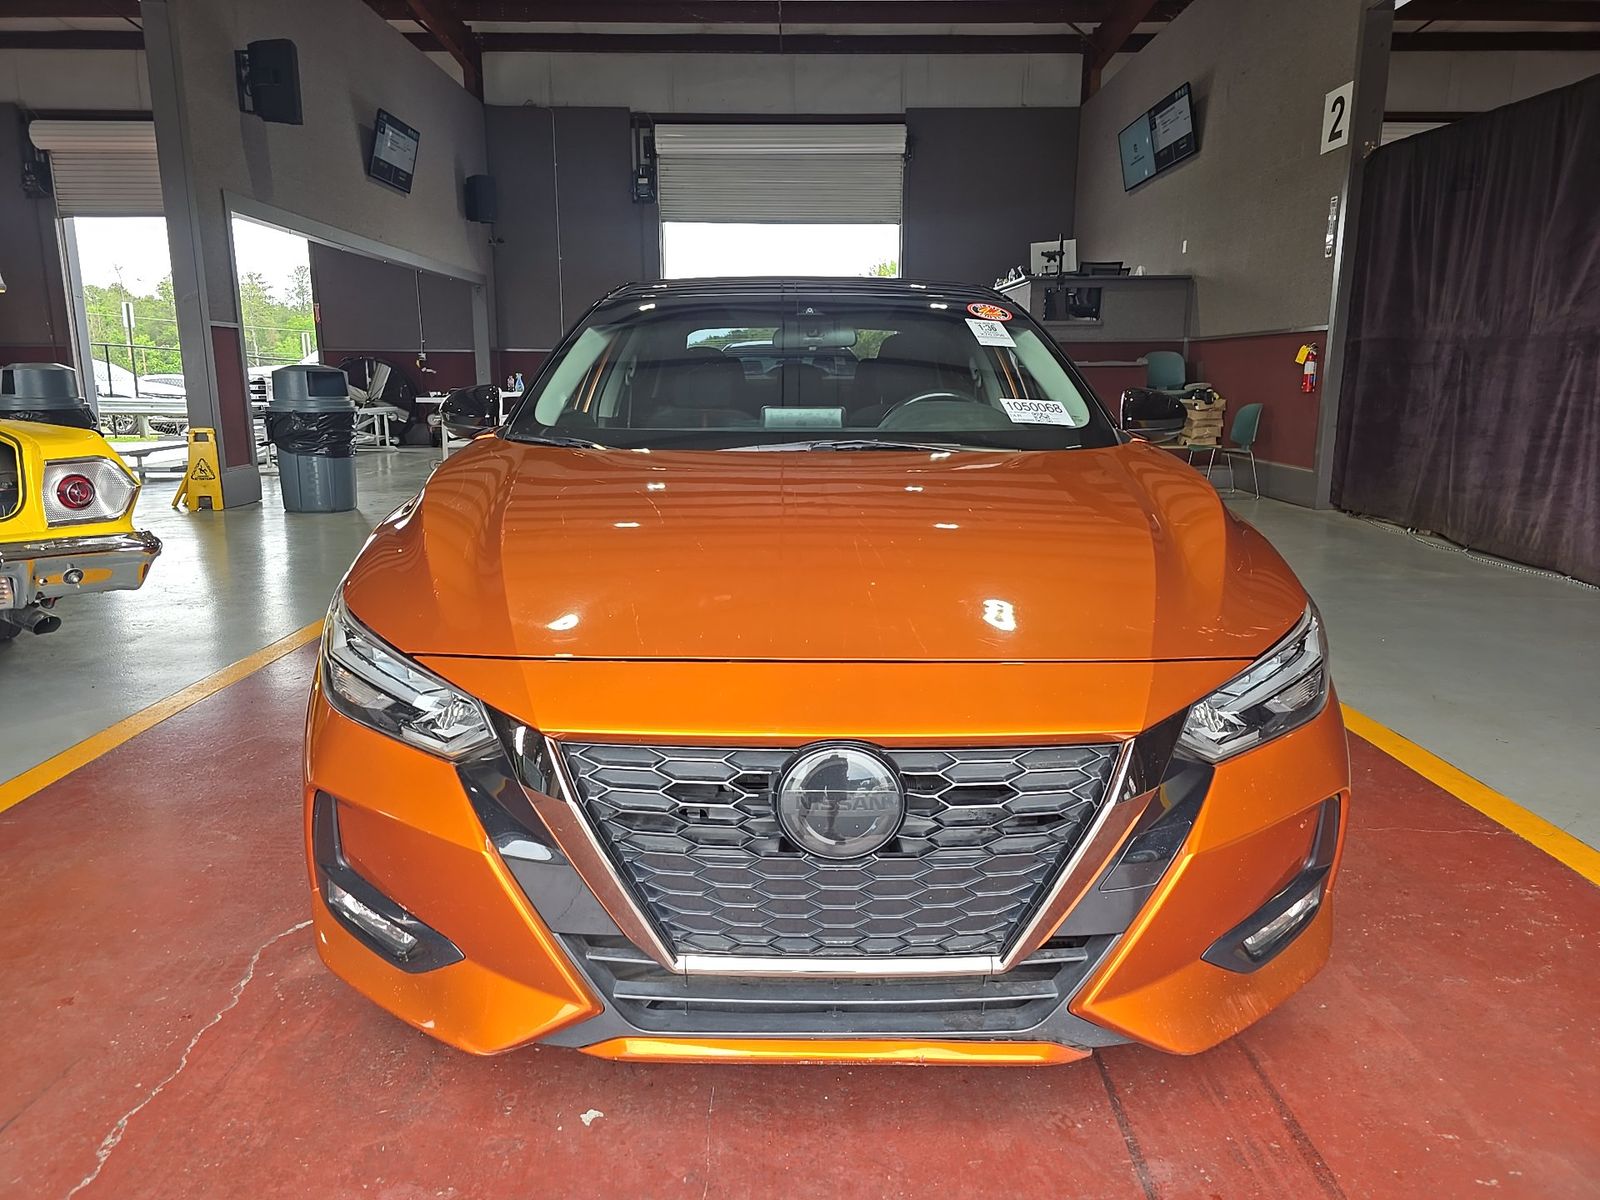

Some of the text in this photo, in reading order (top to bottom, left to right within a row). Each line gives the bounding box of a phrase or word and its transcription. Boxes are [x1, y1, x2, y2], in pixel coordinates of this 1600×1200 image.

[1328, 95, 1345, 143] 2
[1006, 401, 1063, 414] 1050068
[795, 796, 893, 811] NISSAN
